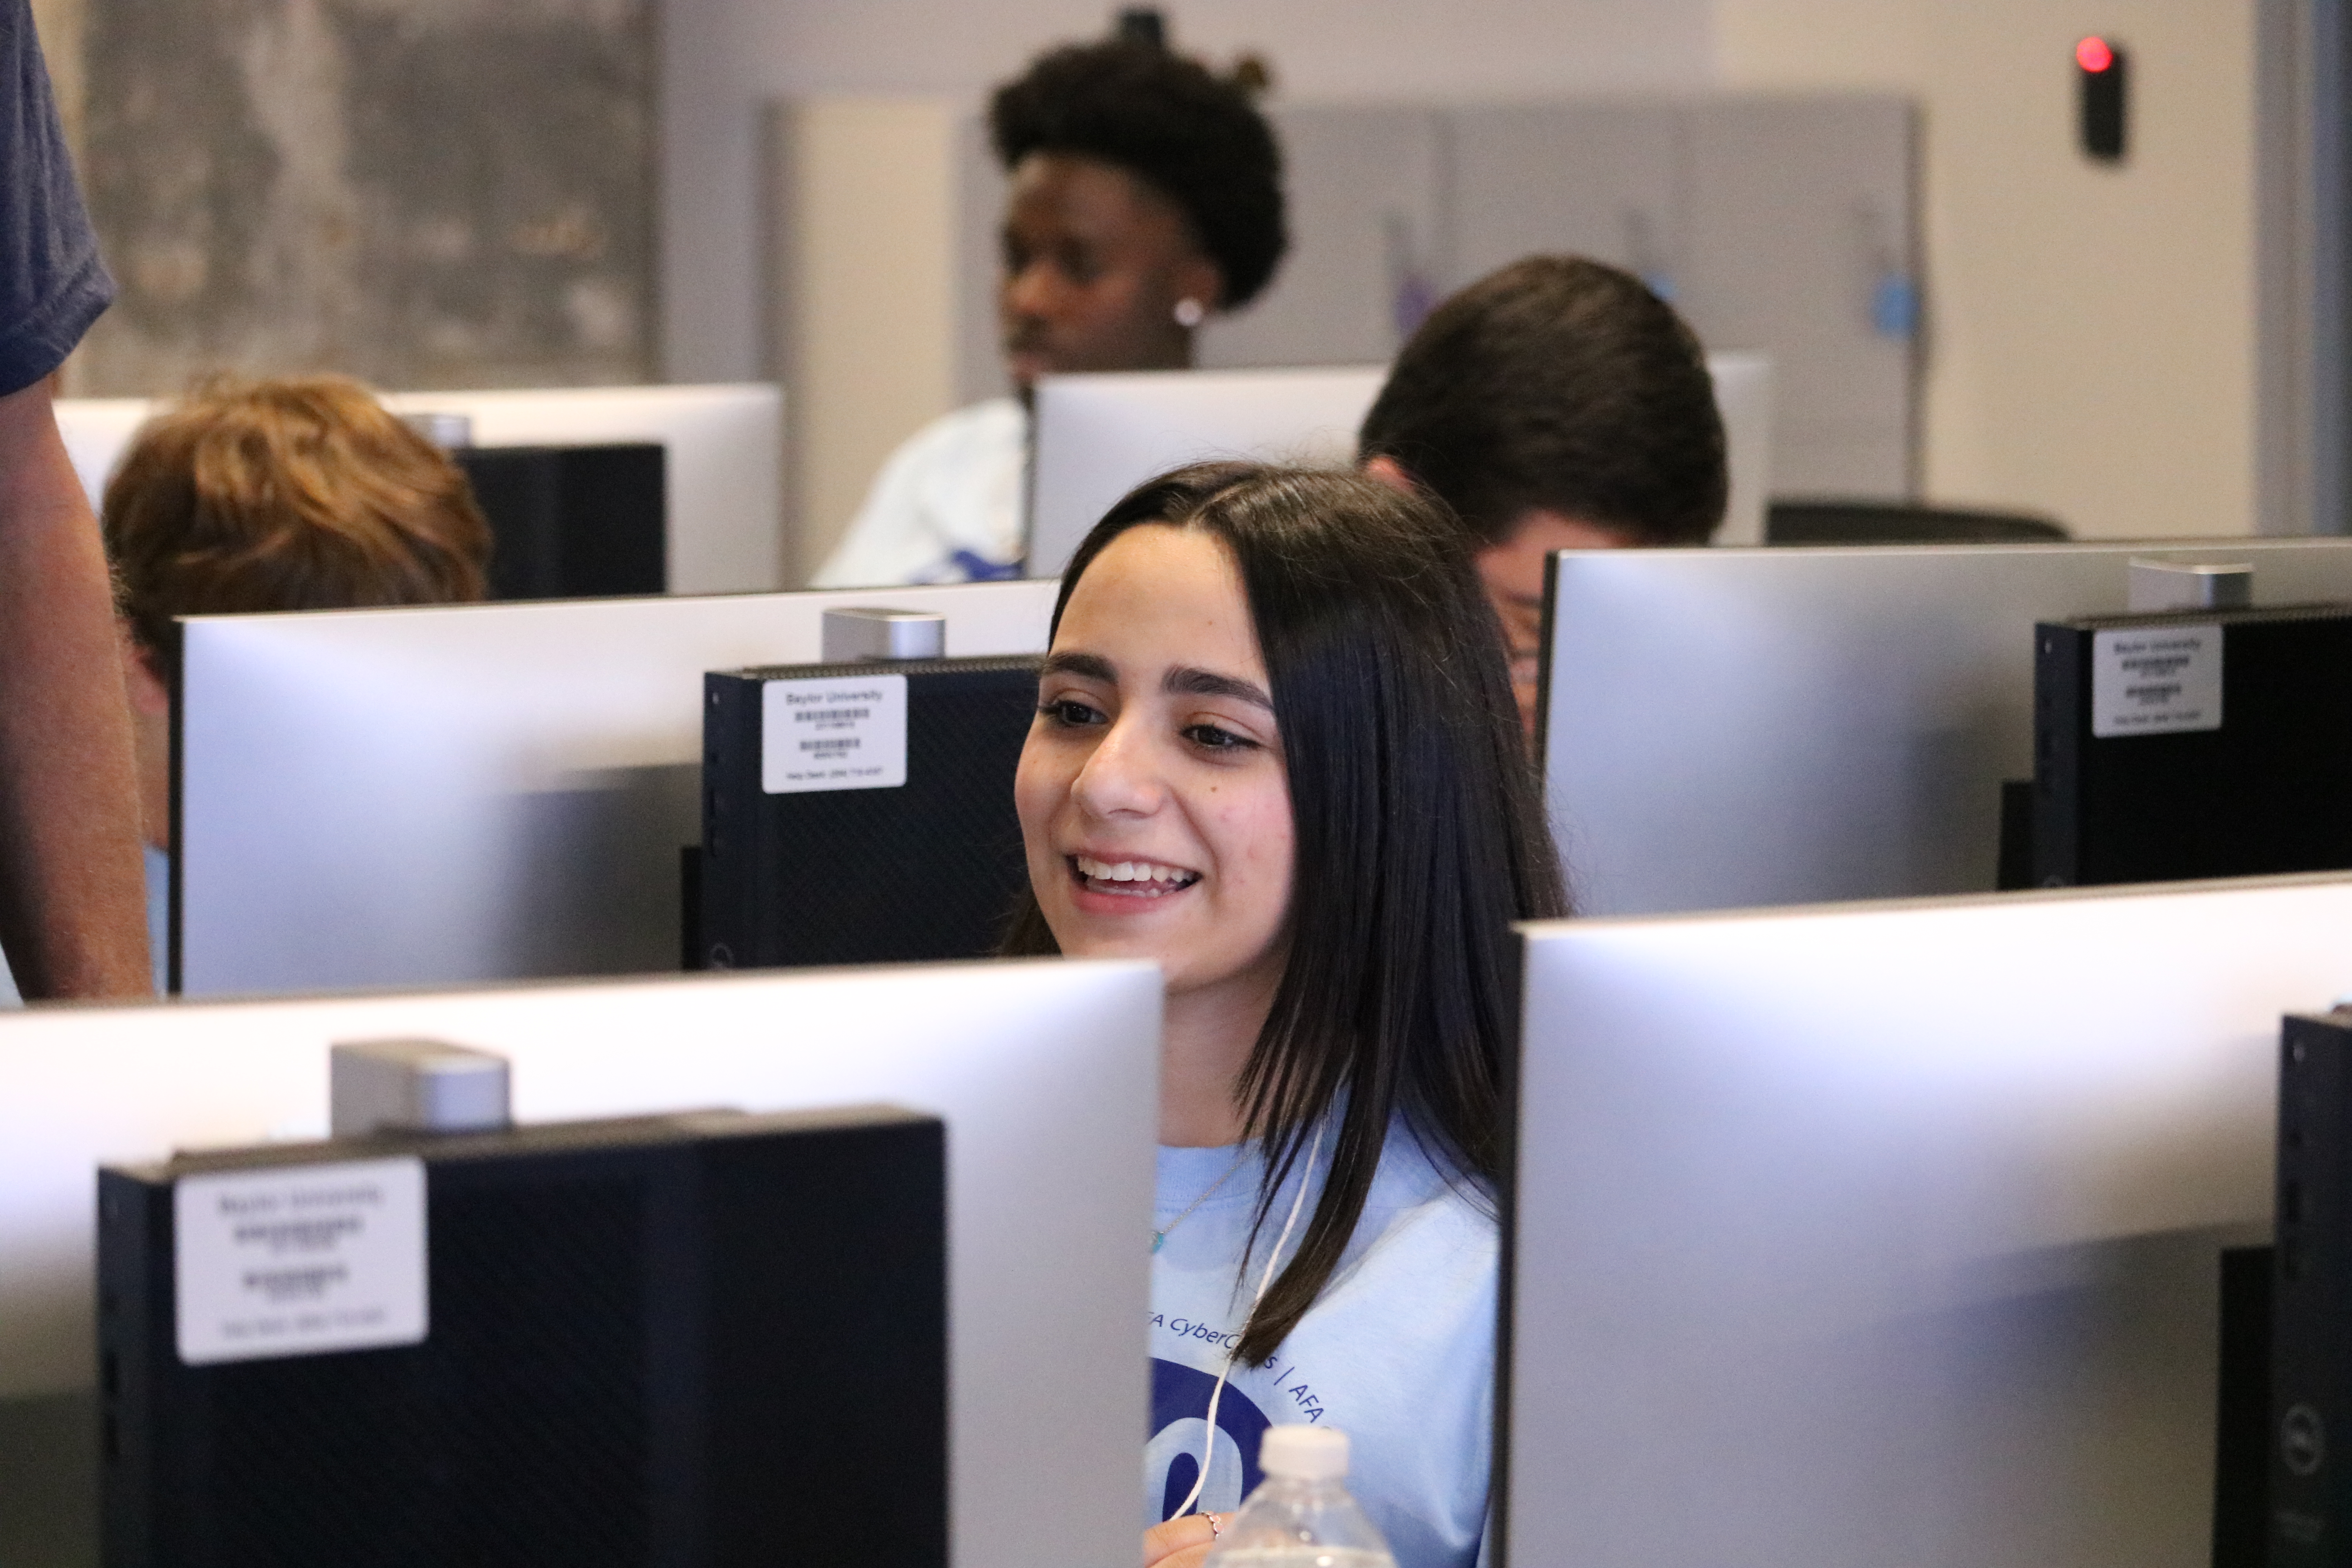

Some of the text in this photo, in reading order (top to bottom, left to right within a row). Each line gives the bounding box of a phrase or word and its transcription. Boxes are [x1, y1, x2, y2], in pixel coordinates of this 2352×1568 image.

[787, 690, 882, 705] Baylor University
[1289, 1384, 1324, 1423] AFA
